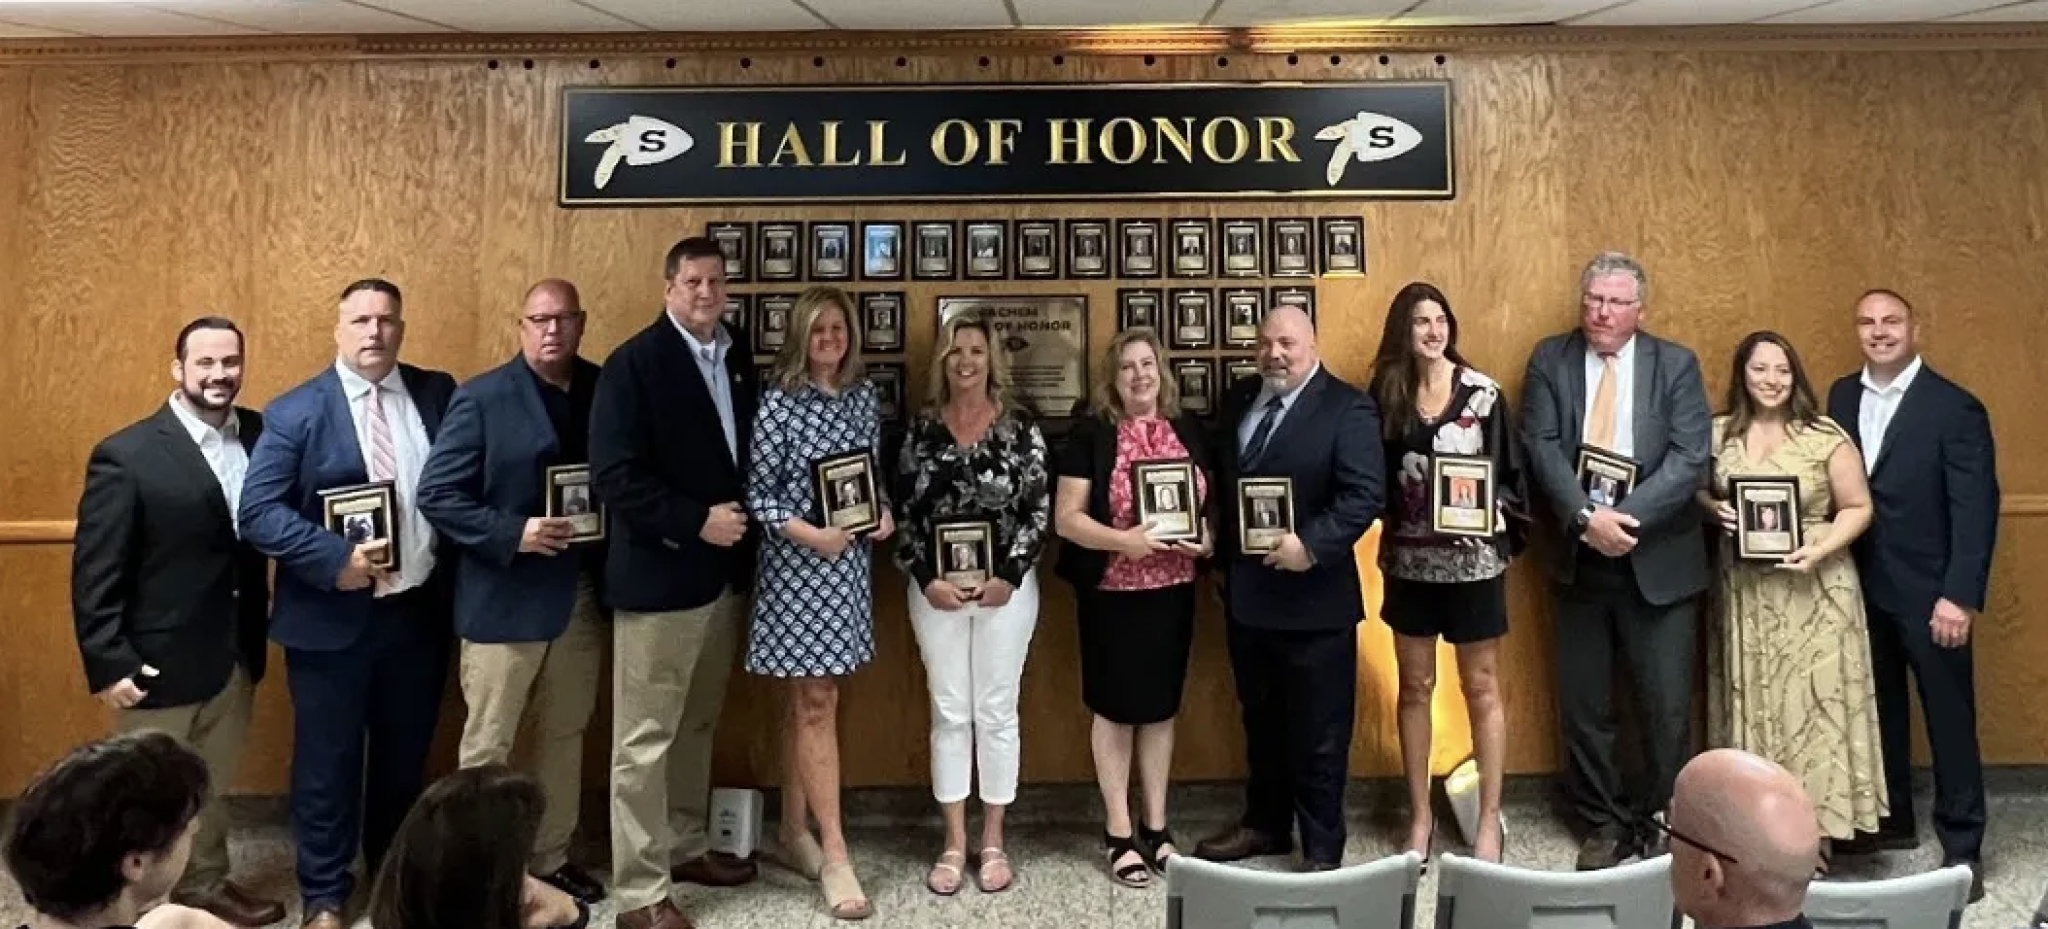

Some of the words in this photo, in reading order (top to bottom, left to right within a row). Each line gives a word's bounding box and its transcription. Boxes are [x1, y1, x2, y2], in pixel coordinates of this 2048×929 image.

[640, 129, 666, 152] S
[716, 121, 907, 169] HALL
[930, 119, 1023, 167] OF
[1046, 116, 1303, 165] HONOR
[1369, 126, 1394, 149] S
[1018, 320, 1071, 332] HONOR
